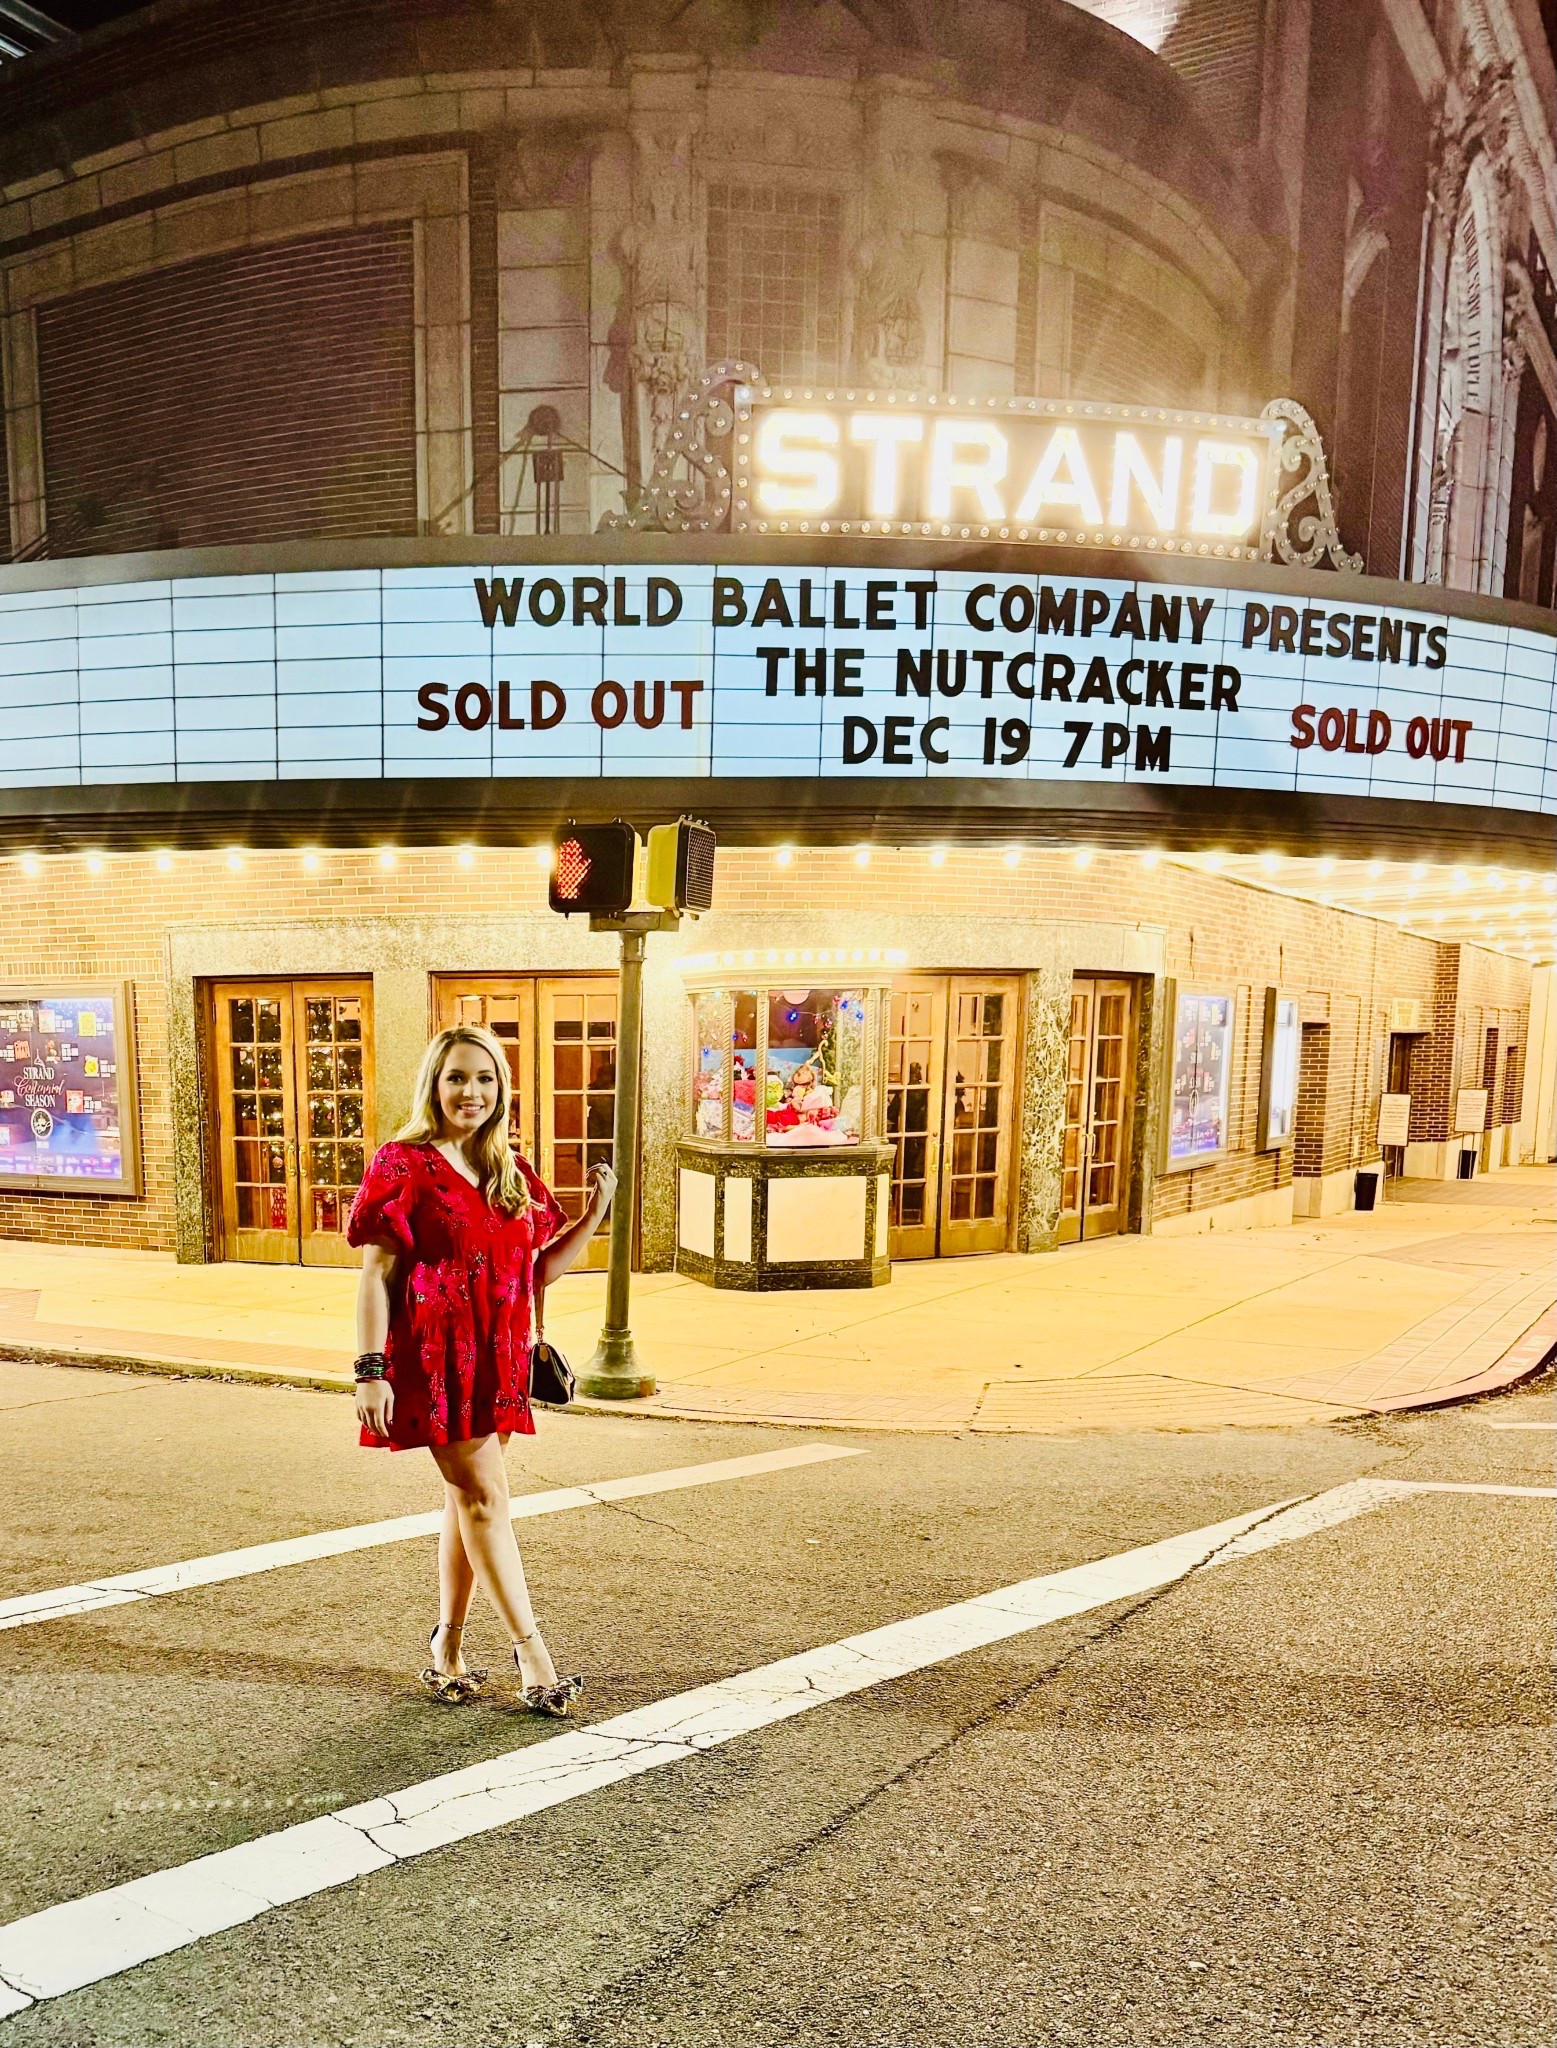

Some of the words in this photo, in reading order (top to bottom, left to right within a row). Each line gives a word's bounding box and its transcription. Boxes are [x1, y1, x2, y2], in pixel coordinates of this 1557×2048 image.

[758, 413, 1258, 536] STRAND
[473, 577, 682, 627] WORLD
[712, 577, 937, 630] BALLET
[965, 583, 1215, 645] COMPANY
[1243, 602, 1448, 669] PRESENTS
[417, 681, 566, 731] SOLD
[591, 680, 704, 729] OUT
[756, 647, 864, 696] THE
[895, 649, 1242, 712] NUTCRACKER
[842, 716, 949, 764] DEC
[983, 717, 1031, 765] 19
[1290, 704, 1391, 755] SOLD
[1405, 715, 1473, 763] OUT
[23, 1066, 55, 1080] STRAND
[25, 1094, 56, 1108] SEASON
